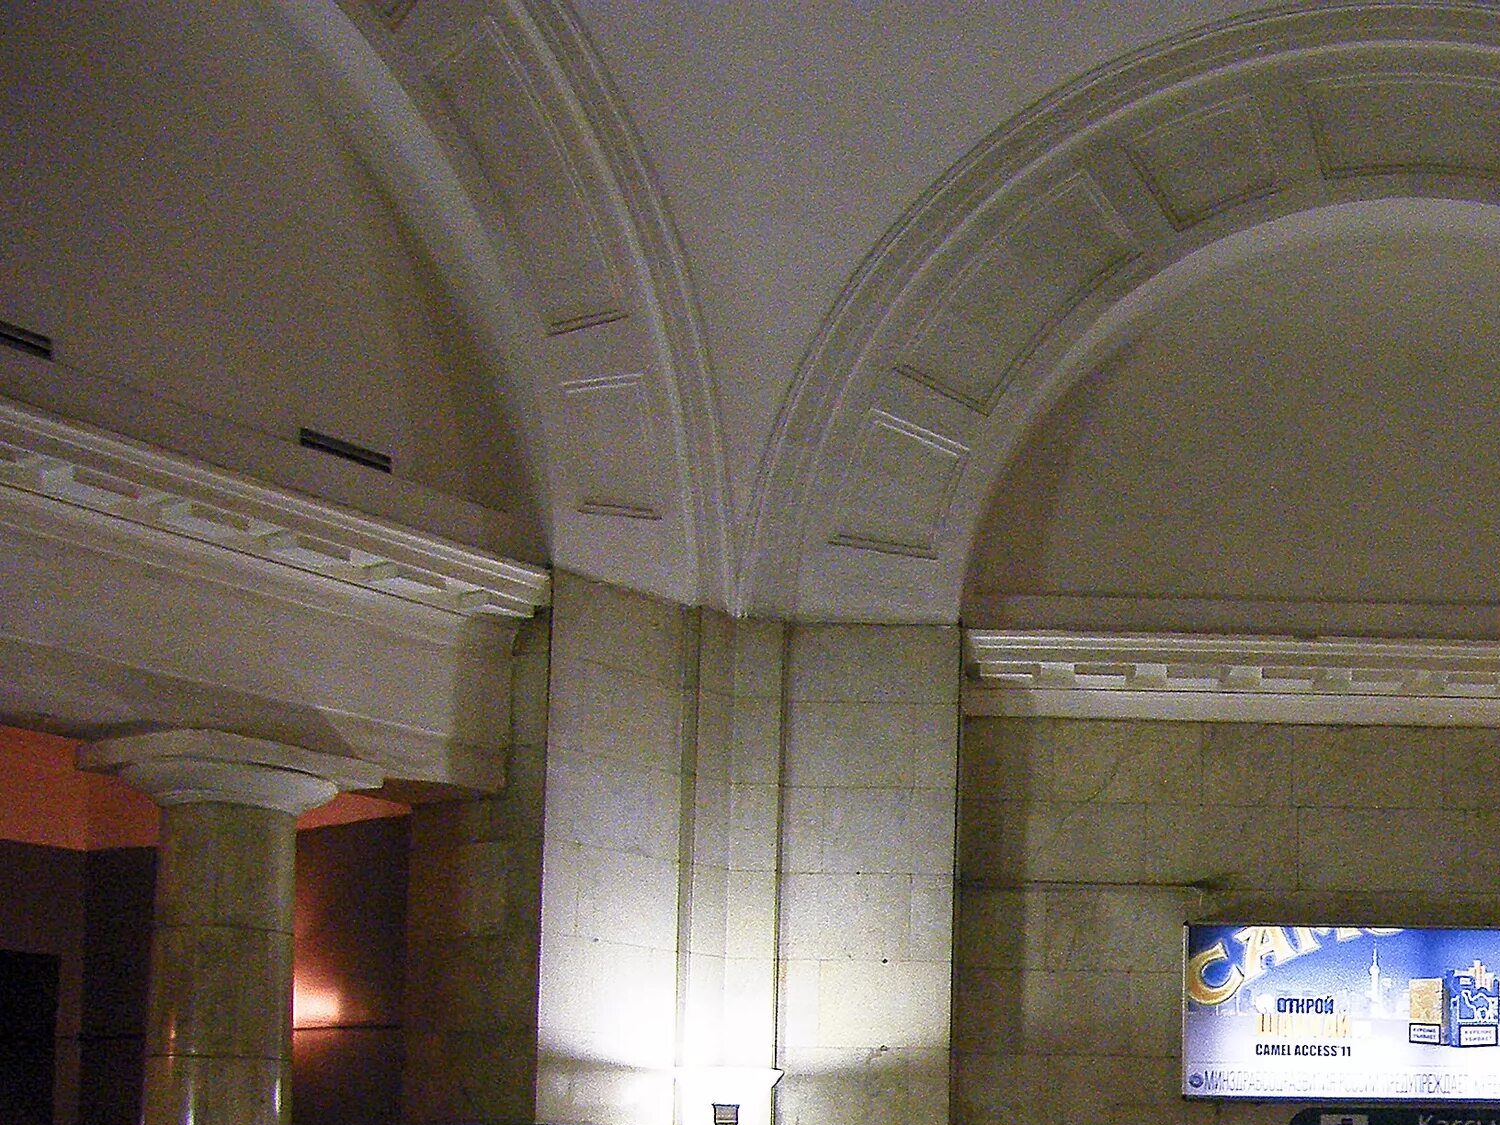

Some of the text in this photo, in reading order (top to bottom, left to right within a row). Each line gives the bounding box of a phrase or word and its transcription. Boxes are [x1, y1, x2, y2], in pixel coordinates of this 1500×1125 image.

[1277, 996, 1334, 1014] ОТКРОЙ
[1255, 1043, 1291, 1056] CAMEL
[1294, 1045, 1338, 1057] ACCESS
